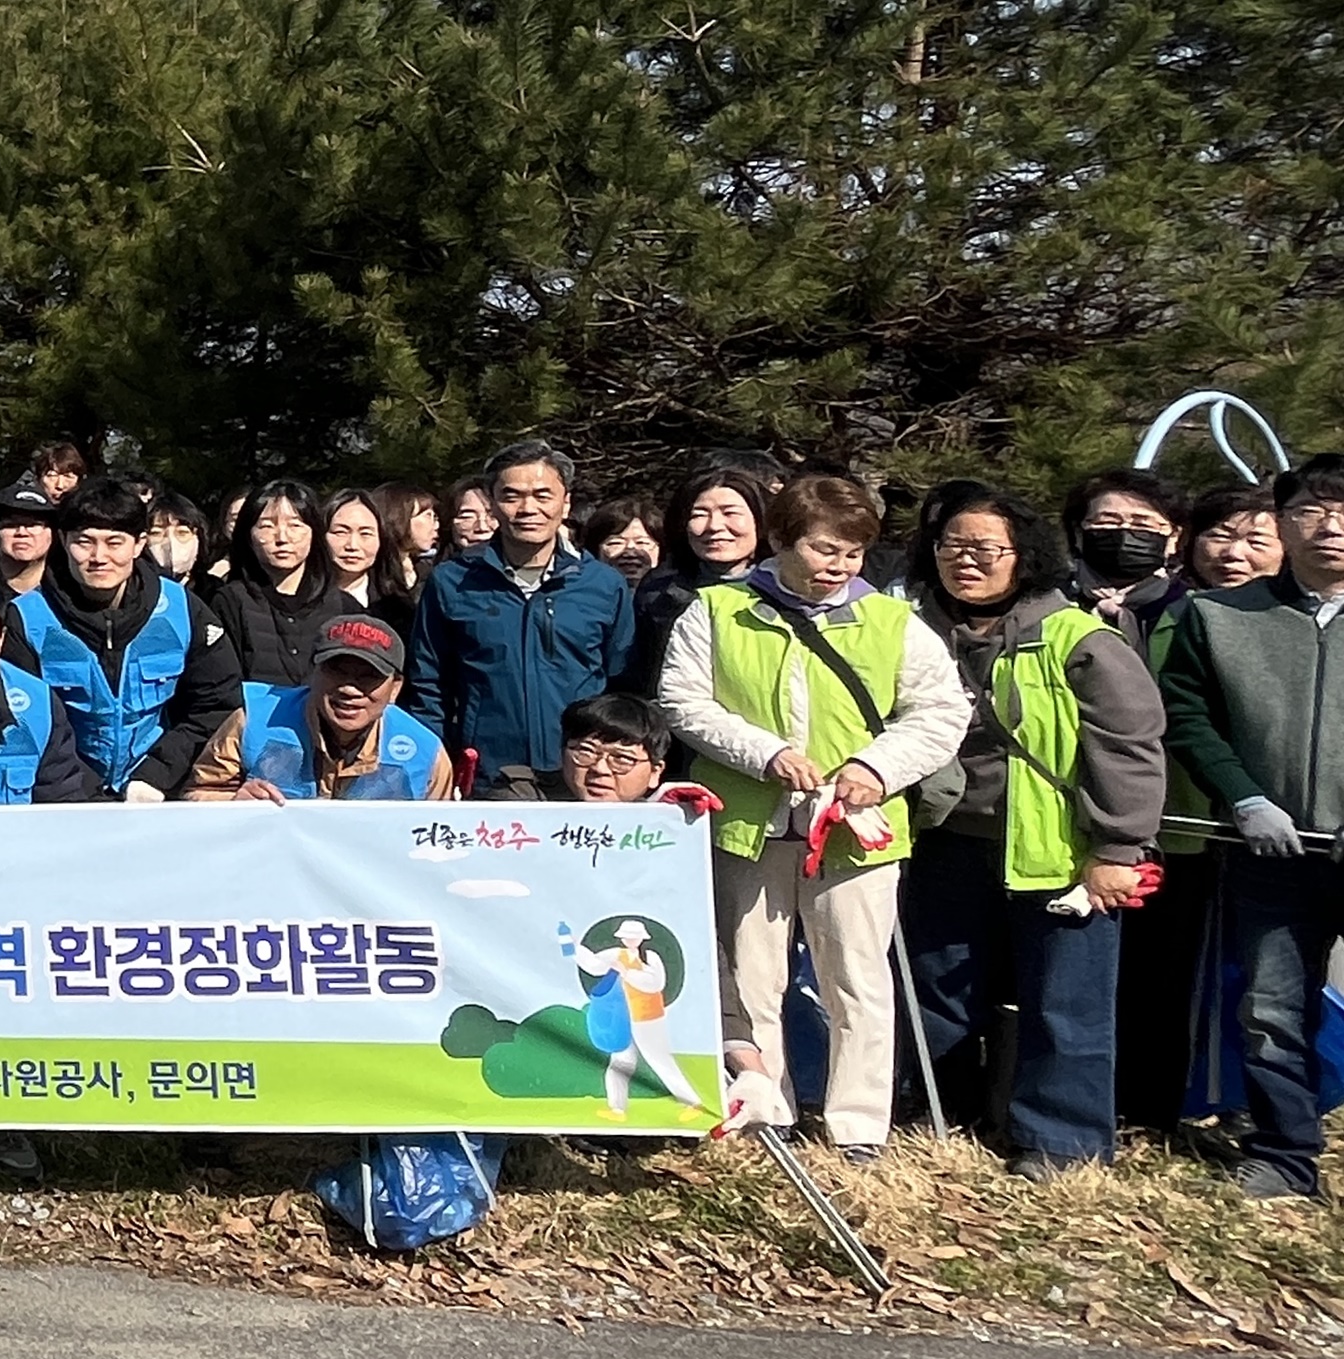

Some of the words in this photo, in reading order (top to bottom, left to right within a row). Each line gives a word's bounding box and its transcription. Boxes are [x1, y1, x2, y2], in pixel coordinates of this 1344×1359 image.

[619, 825, 676, 850] 시민
[48, 923, 439, 996] 환경정화활동
[147, 1060, 257, 1100] 문의면
